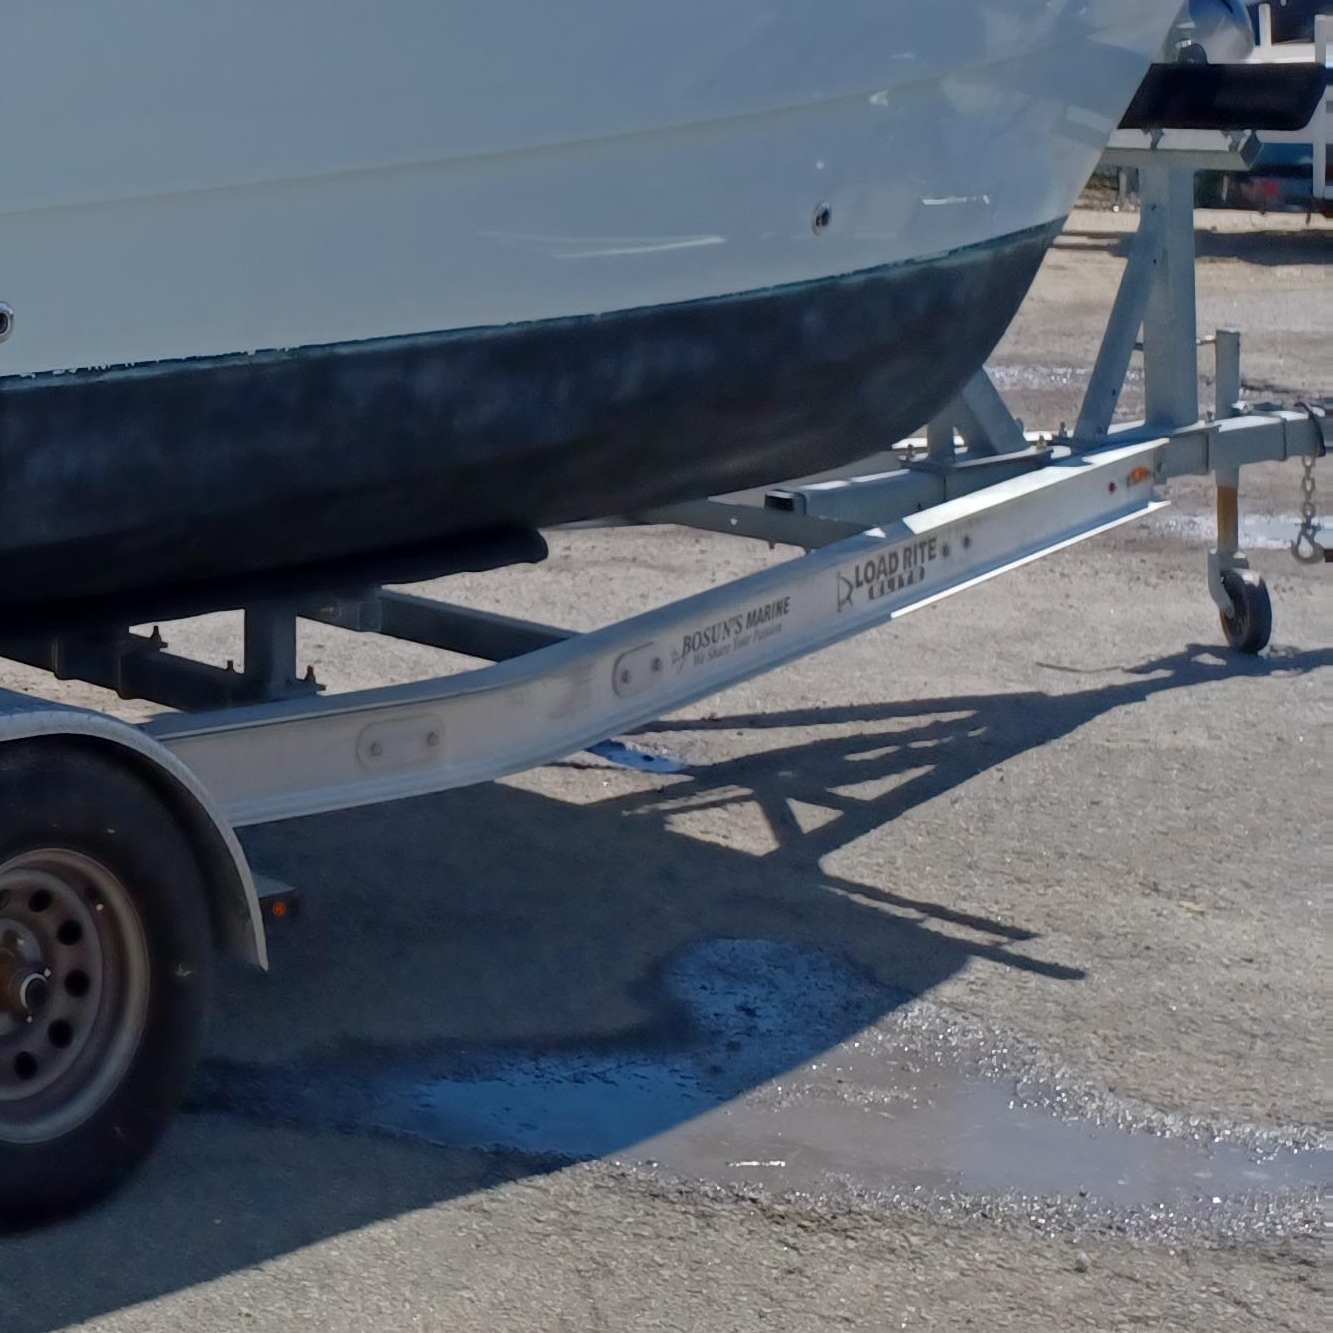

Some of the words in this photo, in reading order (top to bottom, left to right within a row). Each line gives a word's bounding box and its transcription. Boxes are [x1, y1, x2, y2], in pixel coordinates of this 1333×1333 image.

[854, 551, 901, 589] LOAD
[902, 537, 938, 569] RITE
[745, 595, 792, 629] MARINE
